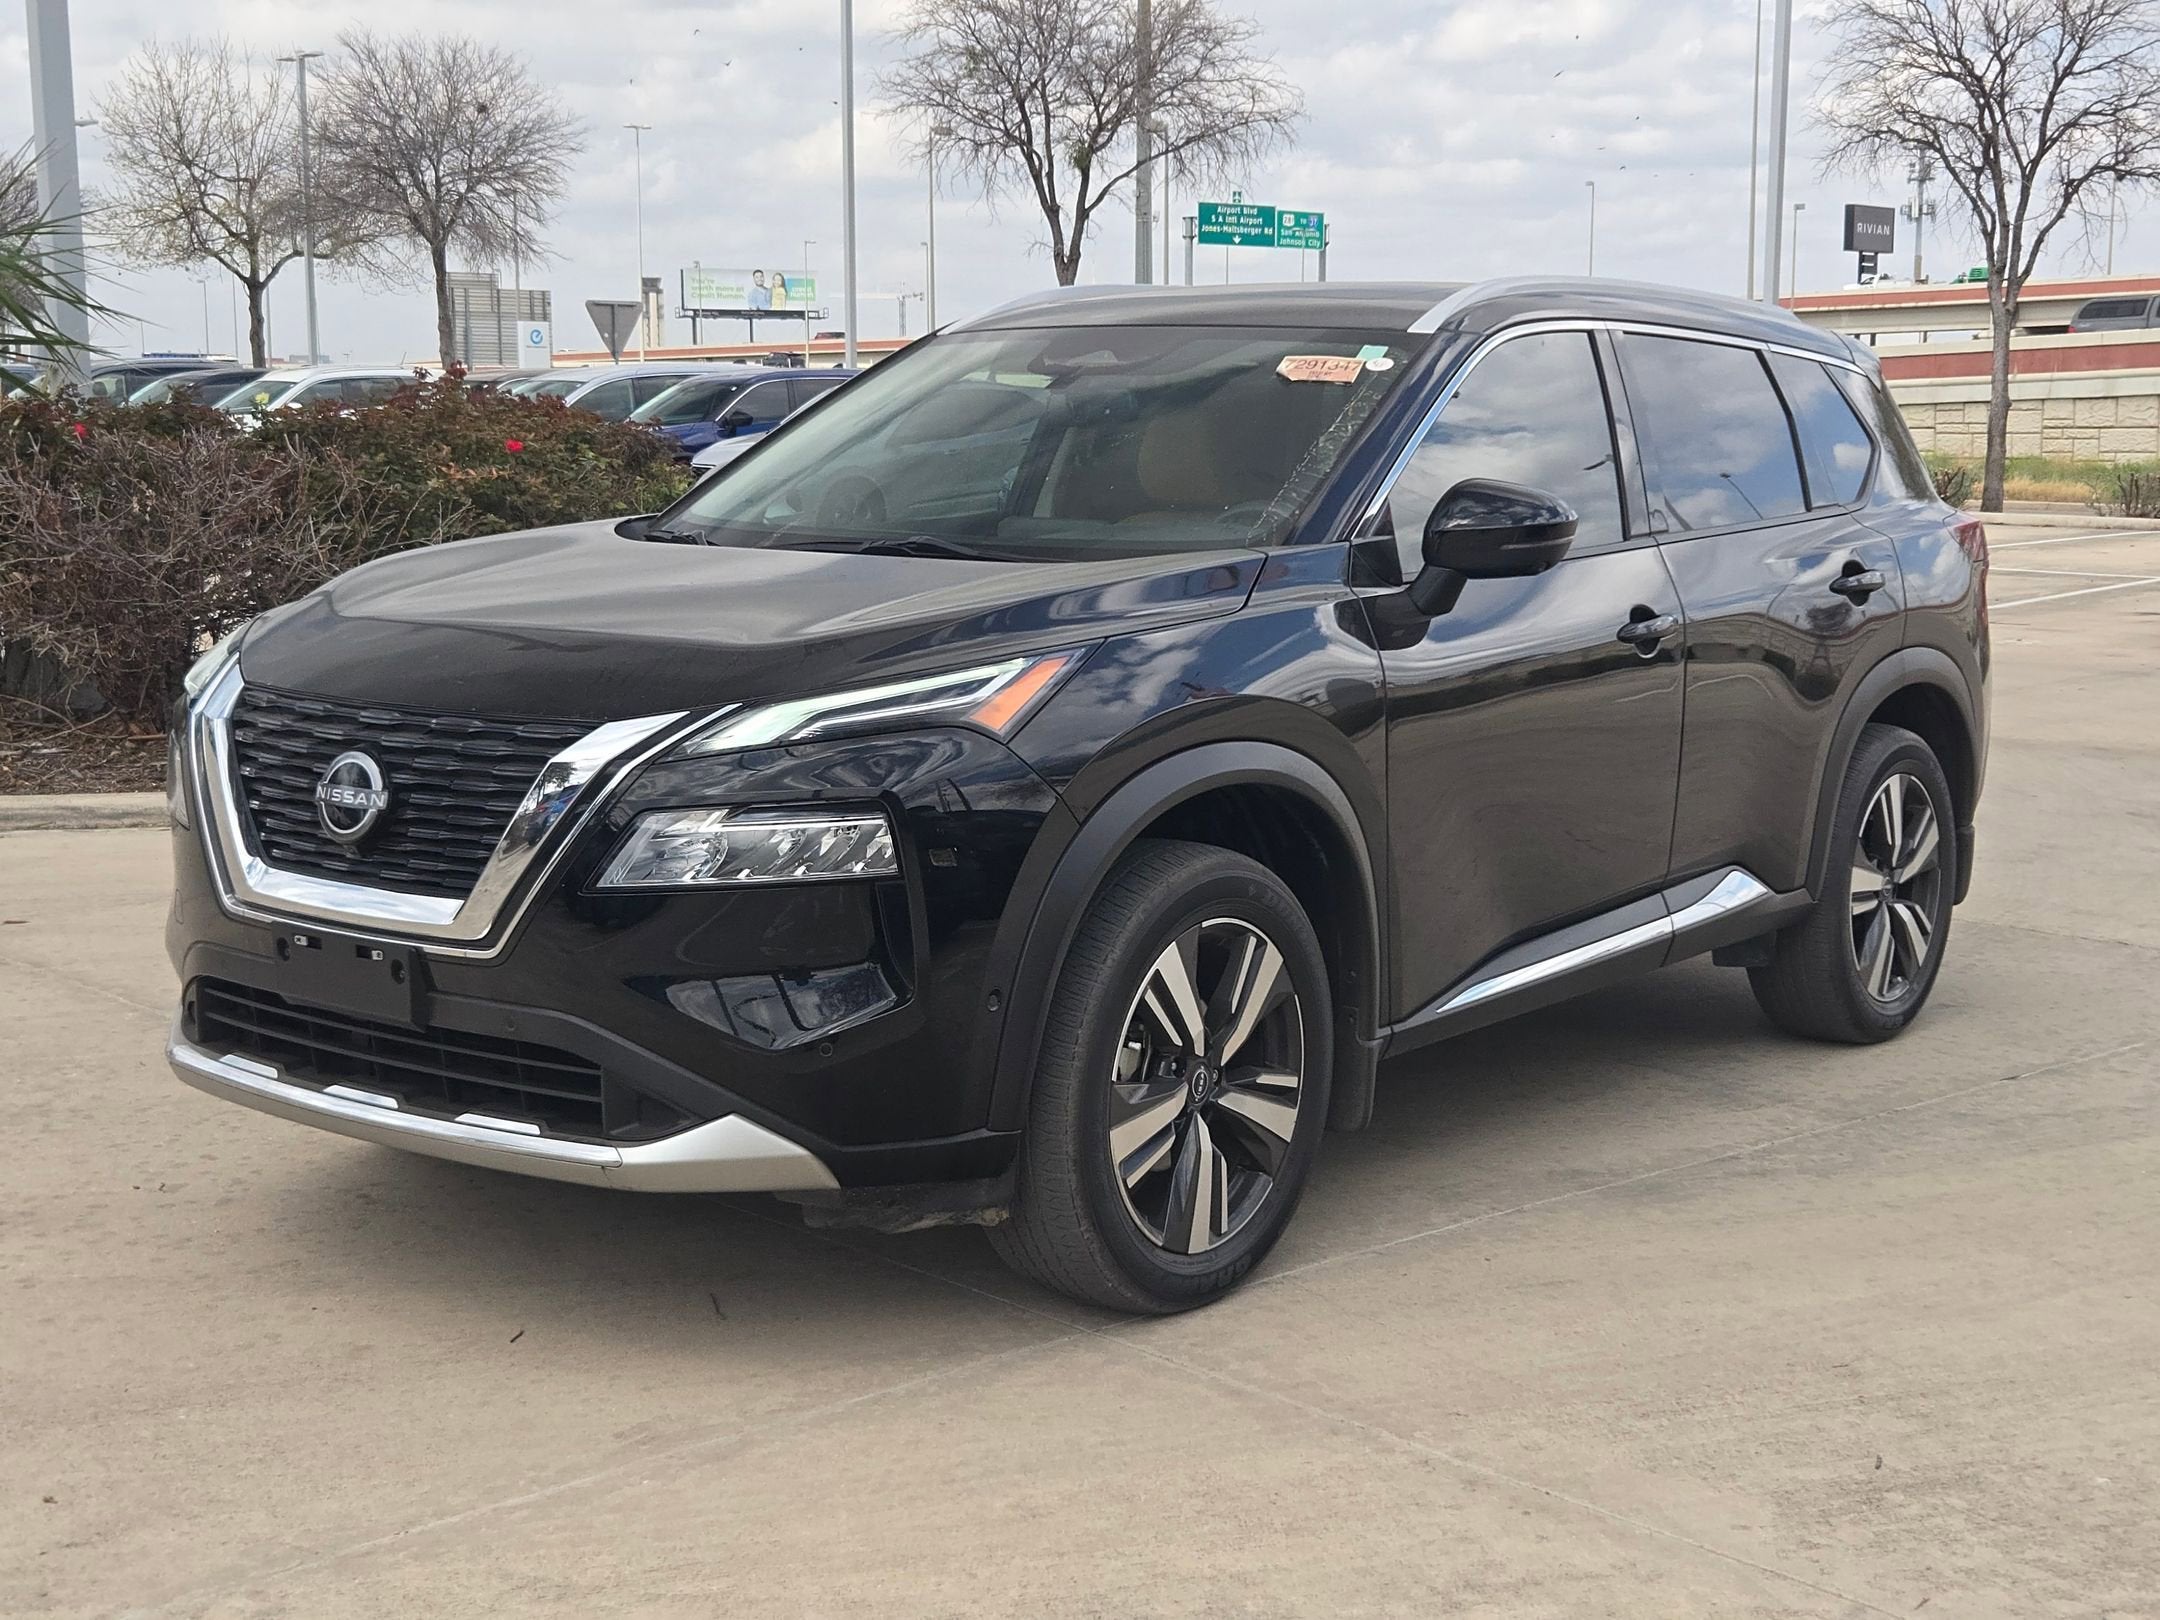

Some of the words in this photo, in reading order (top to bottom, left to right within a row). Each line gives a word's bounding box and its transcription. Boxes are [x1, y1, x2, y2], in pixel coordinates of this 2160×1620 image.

[1217, 206, 1241, 215] Airport
[1243, 207, 1258, 215] Blvd
[1211, 215, 1216, 223] S
[1240, 216, 1263, 226] Airport
[1202, 224, 1262, 236] Jones-Maltsberger
[1264, 227, 1273, 235] Rd
[1280, 228, 1293, 237] San
[1857, 222, 1890, 235] RIVIAN
[1308, 239, 1321, 249] City
[1285, 359, 1362, 372] 7291347
[316, 785, 385, 807] NISSAN
